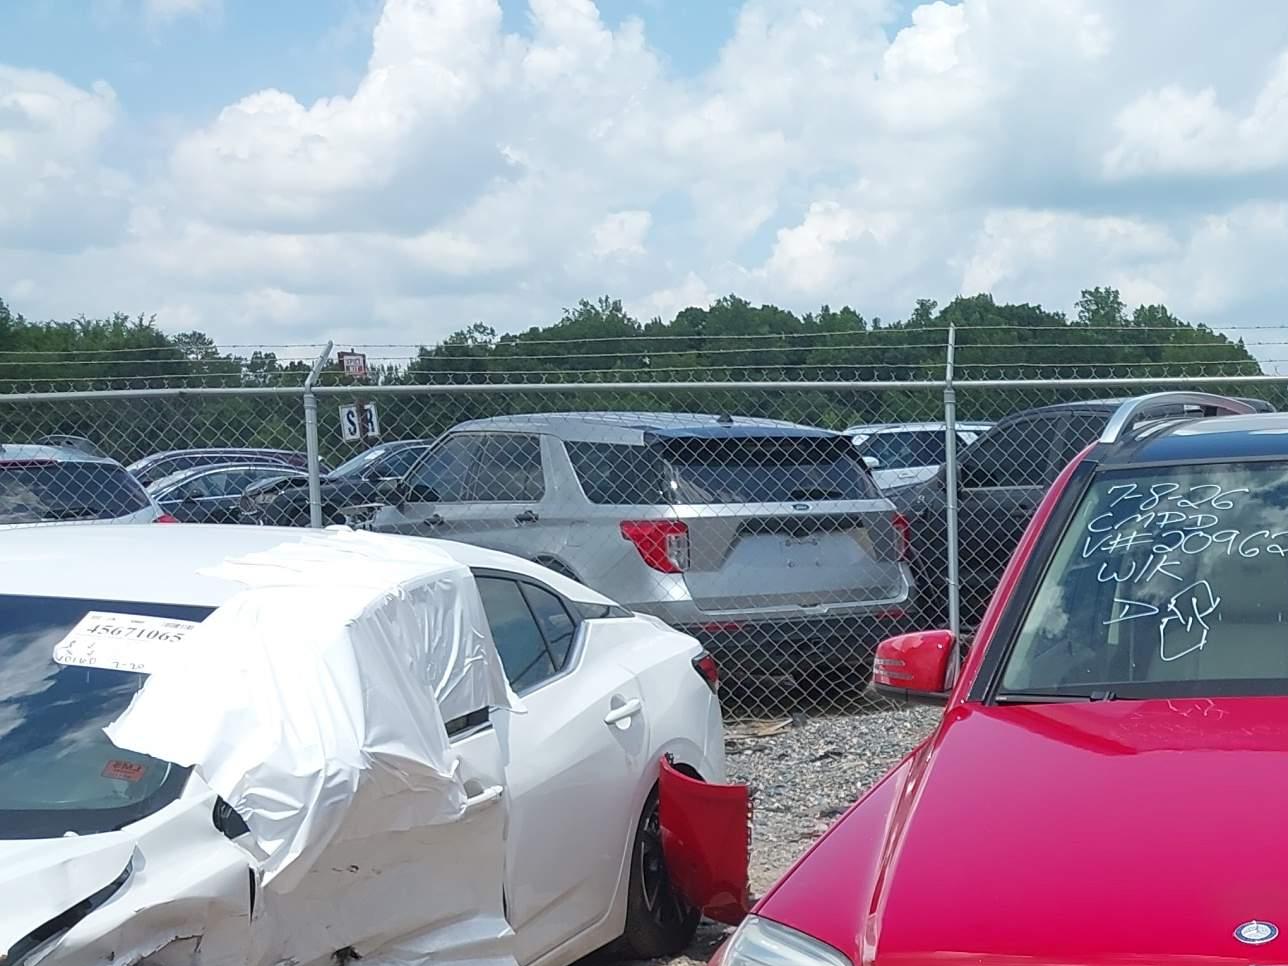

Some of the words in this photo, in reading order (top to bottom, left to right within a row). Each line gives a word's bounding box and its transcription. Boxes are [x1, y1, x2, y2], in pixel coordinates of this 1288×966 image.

[1107, 483, 1249, 511] 7-8-26
[1088, 511, 1219, 532] CMPD
[87, 624, 185, 642] 45671065
